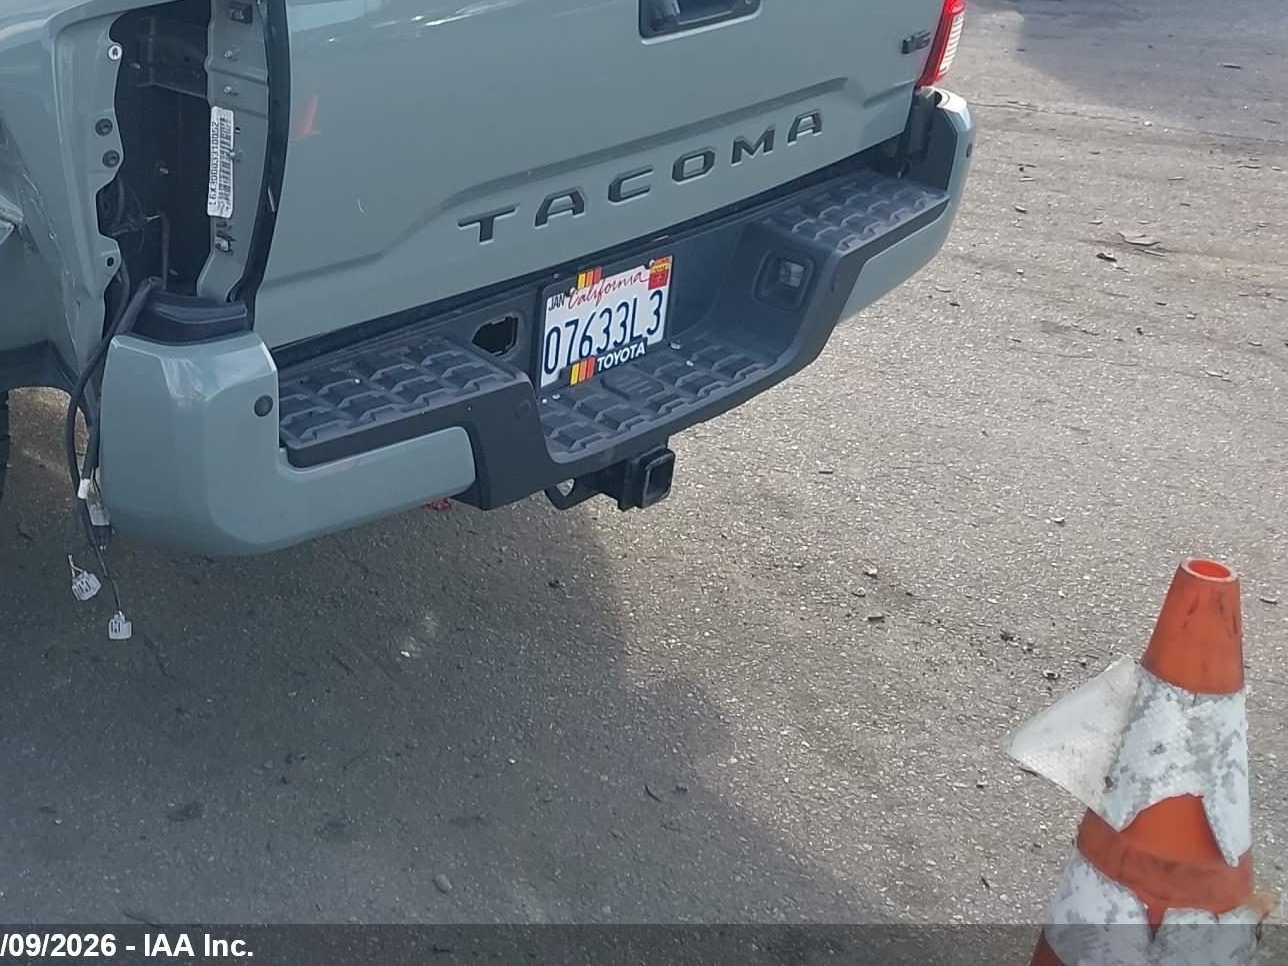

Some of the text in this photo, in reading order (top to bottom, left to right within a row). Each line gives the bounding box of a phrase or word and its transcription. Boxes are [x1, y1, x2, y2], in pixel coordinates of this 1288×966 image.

[457, 108, 824, 245] TACOMA
[548, 272, 650, 311] JAN California
[544, 289, 663, 375] 07633L3
[596, 341, 646, 372] TOYOTA
